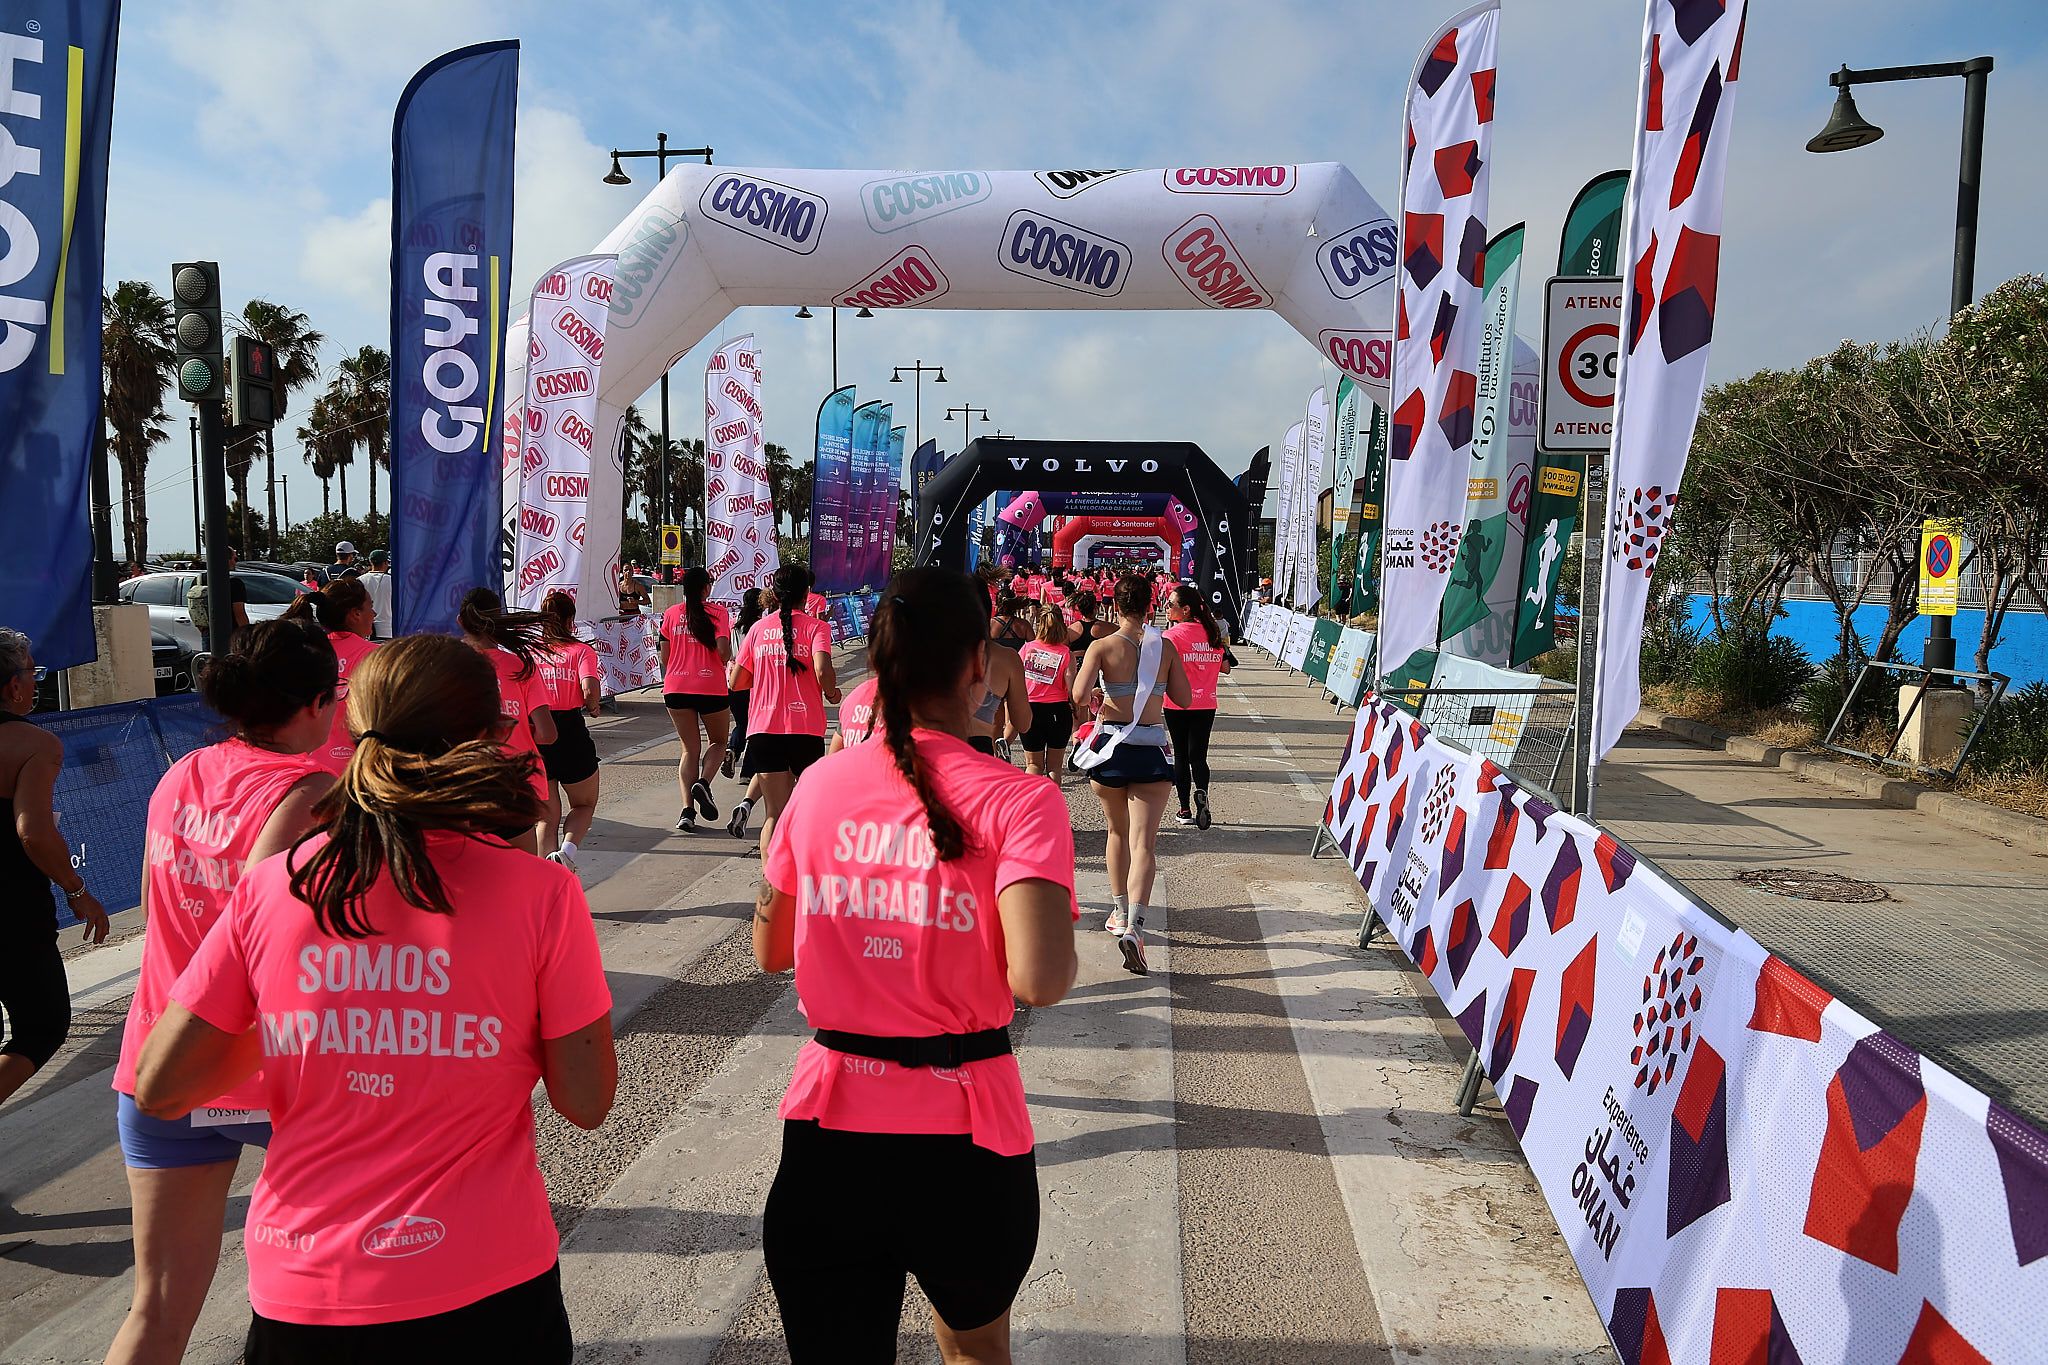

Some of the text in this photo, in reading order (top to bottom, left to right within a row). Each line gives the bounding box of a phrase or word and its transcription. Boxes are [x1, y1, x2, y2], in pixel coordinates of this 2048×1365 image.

[872, 172, 982, 222] COSMO
[1175, 166, 1286, 187] COSMO
[711, 178, 816, 244] COSMO
[1011, 220, 1120, 290] COSMO
[1175, 227, 1263, 309] COSMO
[421, 252, 484, 453] GOYA
[559, 312, 604, 360] COSMO
[1330, 337, 1391, 378] COS
[1478, 323, 1493, 399] Institutos
[536, 371, 588, 397] COSMO
[715, 421, 747, 443] COSMO
[1008, 457, 1159, 474] VOLVO
[1091, 520, 1156, 528] Sports Santander
[1183, 653, 1221, 663] IMPARABLES
[1407, 846, 1429, 877] Experience
[801, 875, 977, 933] MPARABLES
[1390, 887, 1415, 927] OMAN
[863, 936, 903, 960] 2026
[298, 944, 451, 996] SOMOS
[259, 1009, 502, 1059] IMPARABLES
[347, 1070, 395, 1098] 2026
[1602, 1085, 1649, 1165] Experience
[1571, 1161, 1622, 1263] OMAN
[254, 1223, 316, 1254] OYSHO
[368, 1229, 440, 1251] ASTURIANA
